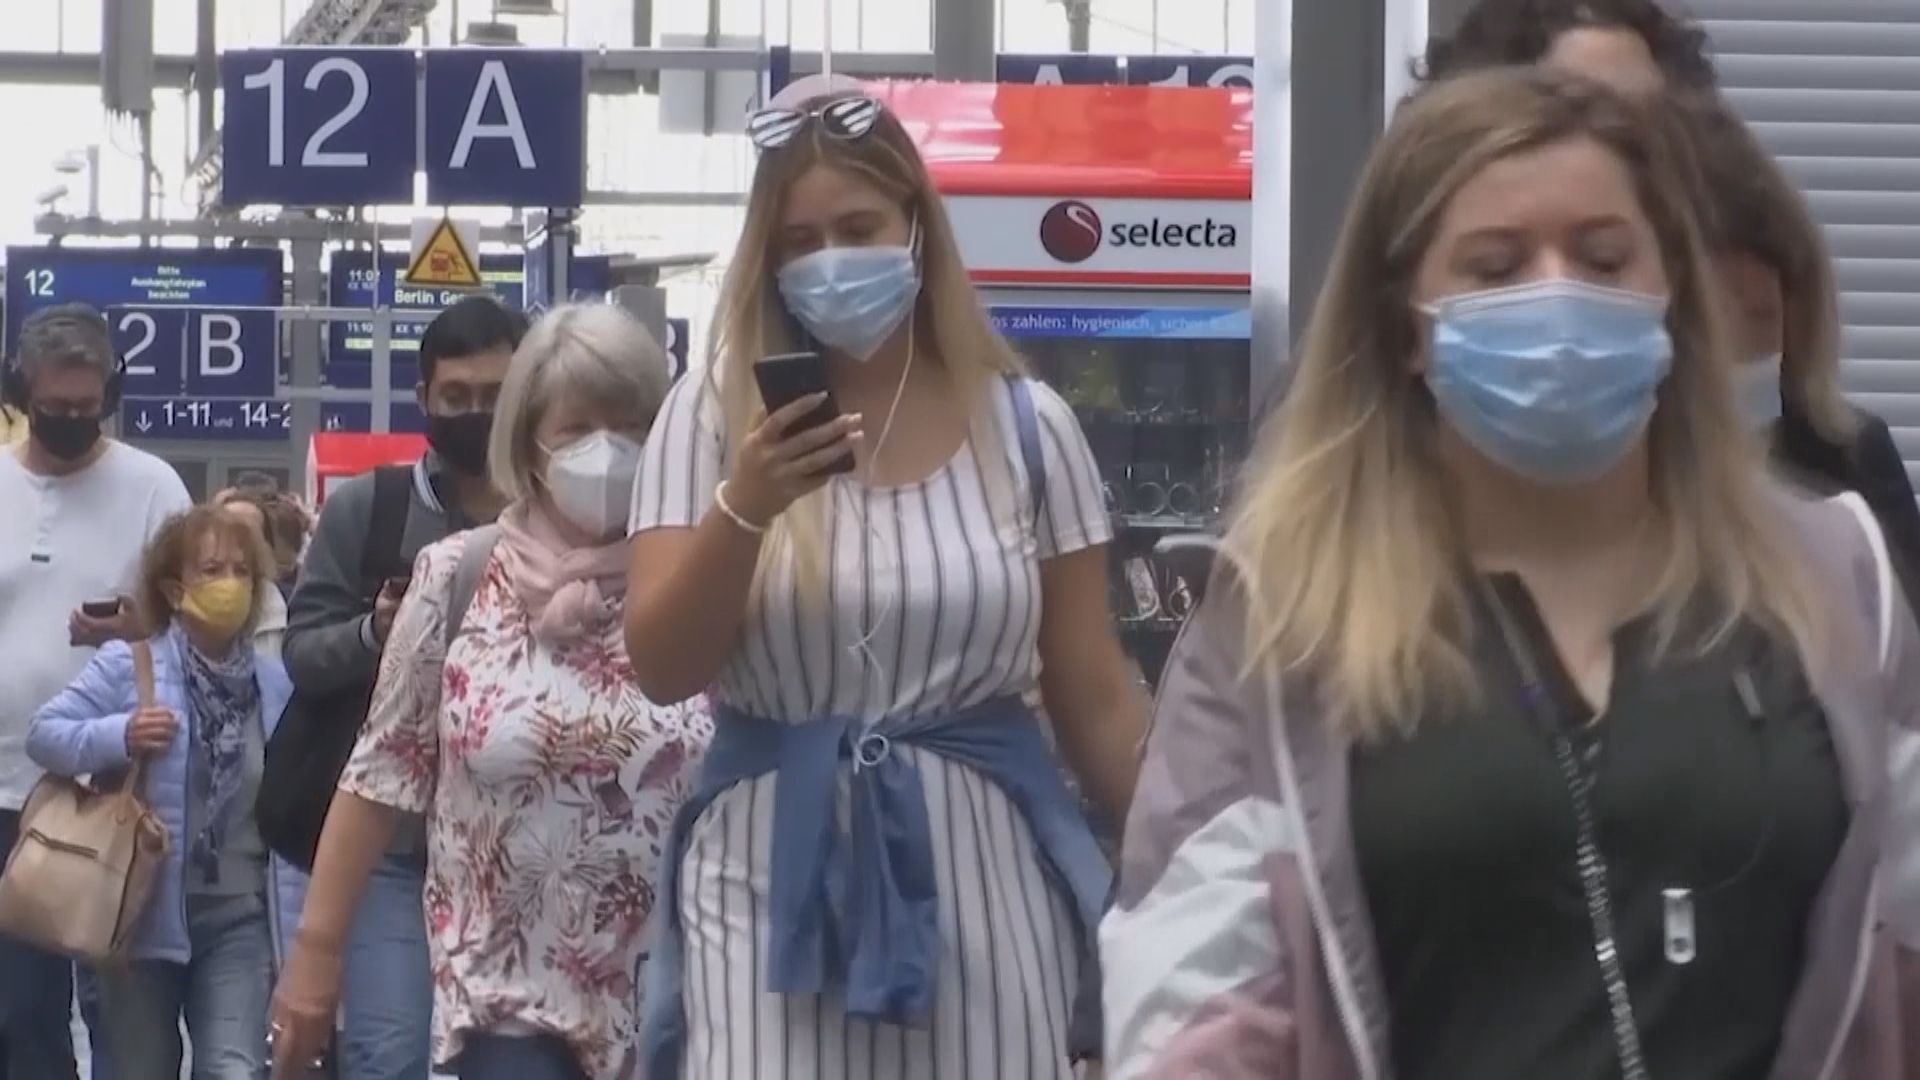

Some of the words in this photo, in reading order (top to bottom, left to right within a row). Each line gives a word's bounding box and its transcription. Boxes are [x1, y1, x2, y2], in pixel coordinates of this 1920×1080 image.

[244, 57, 370, 167] 12
[448, 60, 537, 168] A
[1109, 218, 1237, 247] selecta
[24, 269, 55, 296] 12
[394, 289, 434, 304] Berlin
[1012, 314, 1066, 329] zahlen:
[101, 311, 157, 375] 2
[200, 314, 244, 376] B
[163, 401, 211, 427] 1-11
